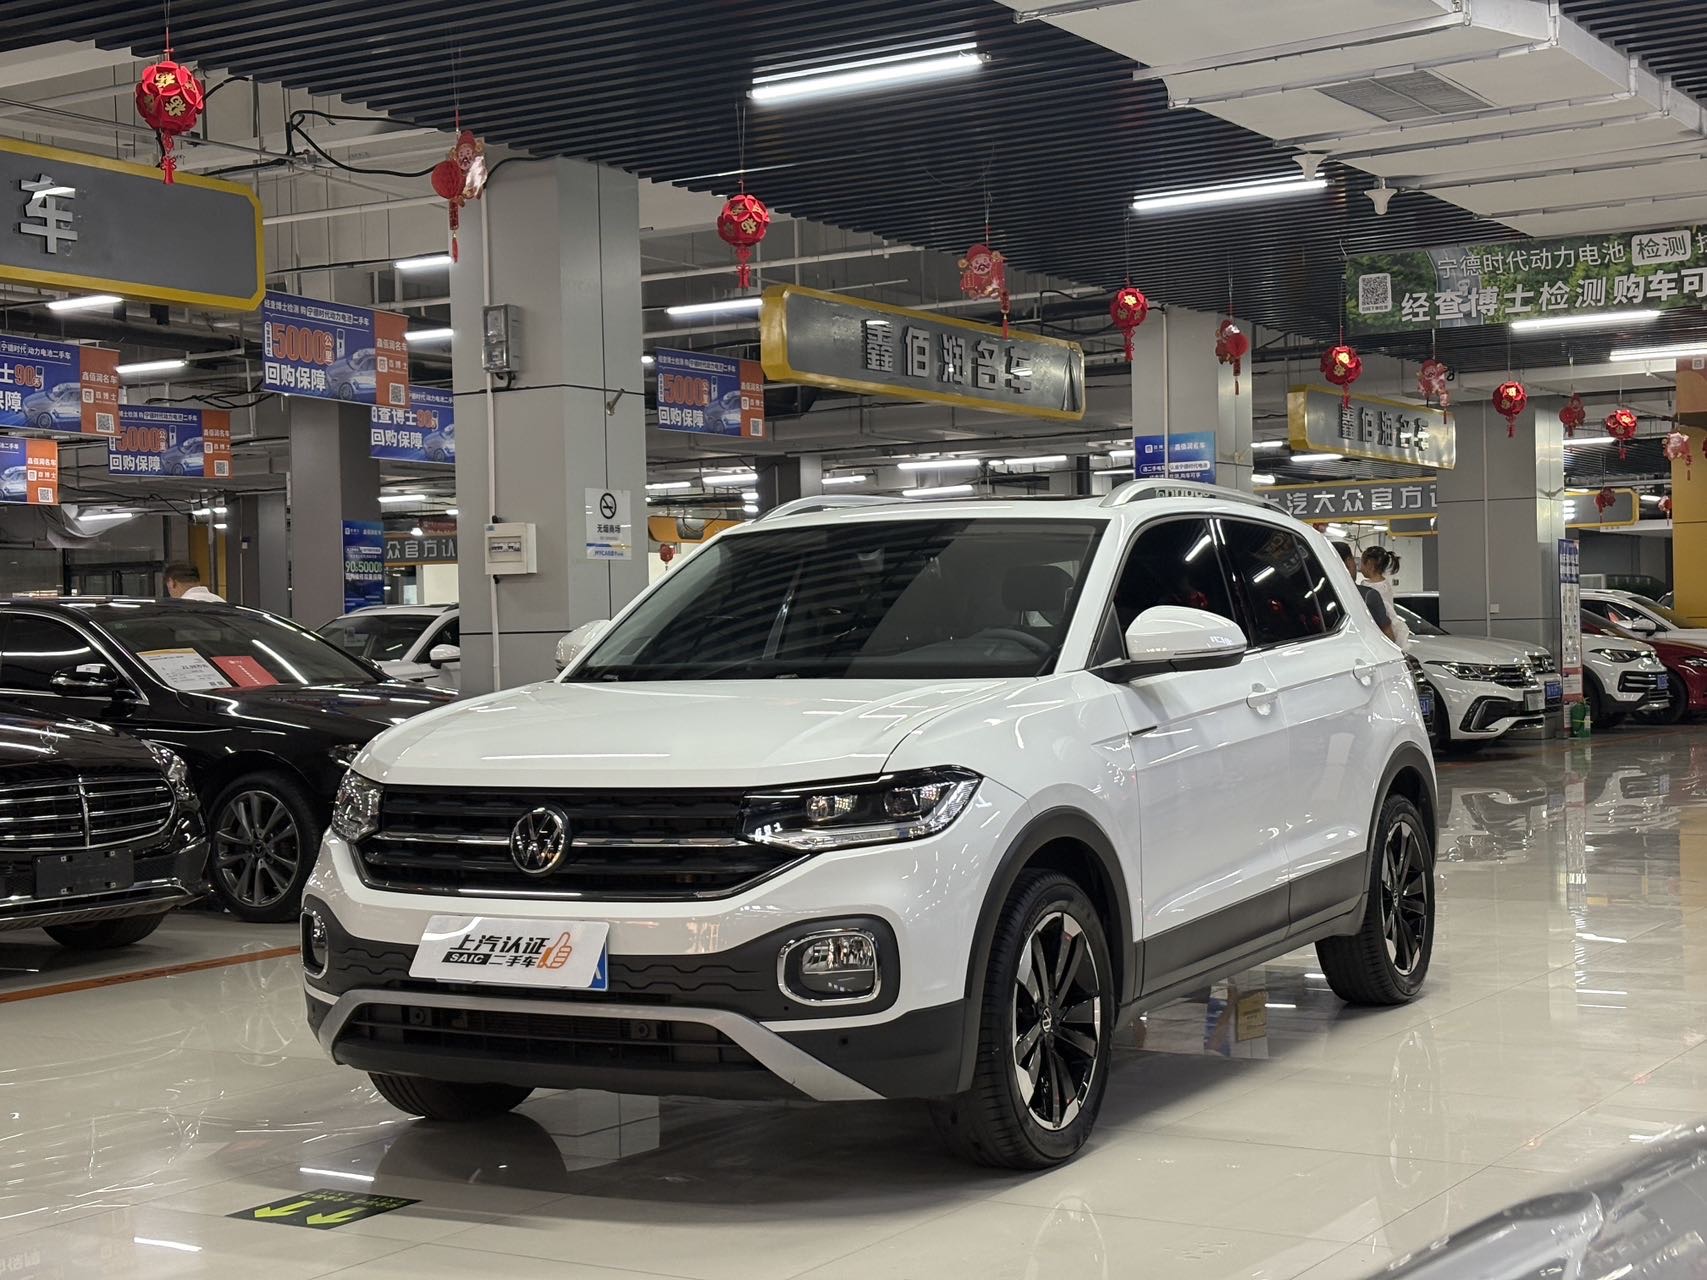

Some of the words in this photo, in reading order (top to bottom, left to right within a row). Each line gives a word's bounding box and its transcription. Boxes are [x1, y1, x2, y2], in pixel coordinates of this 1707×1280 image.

[19, 173, 78, 254] 车
[1438, 242, 1625, 279] 宁德时代动力电池
[1636, 234, 1688, 261] 检测
[1401, 267, 1707, 323] 经查博士检测购车可
[861, 319, 1033, 394] 鑫佰润名车
[264, 362, 326, 391] 回购保障
[658, 406, 704, 428] 回购保障
[371, 428, 423, 449] 回购保障
[109, 454, 161, 471] 回购保障
[450, 934, 550, 954] 上汽认证
[450, 953, 486, 964] SAIC
[488, 954, 540, 968] 二手车
